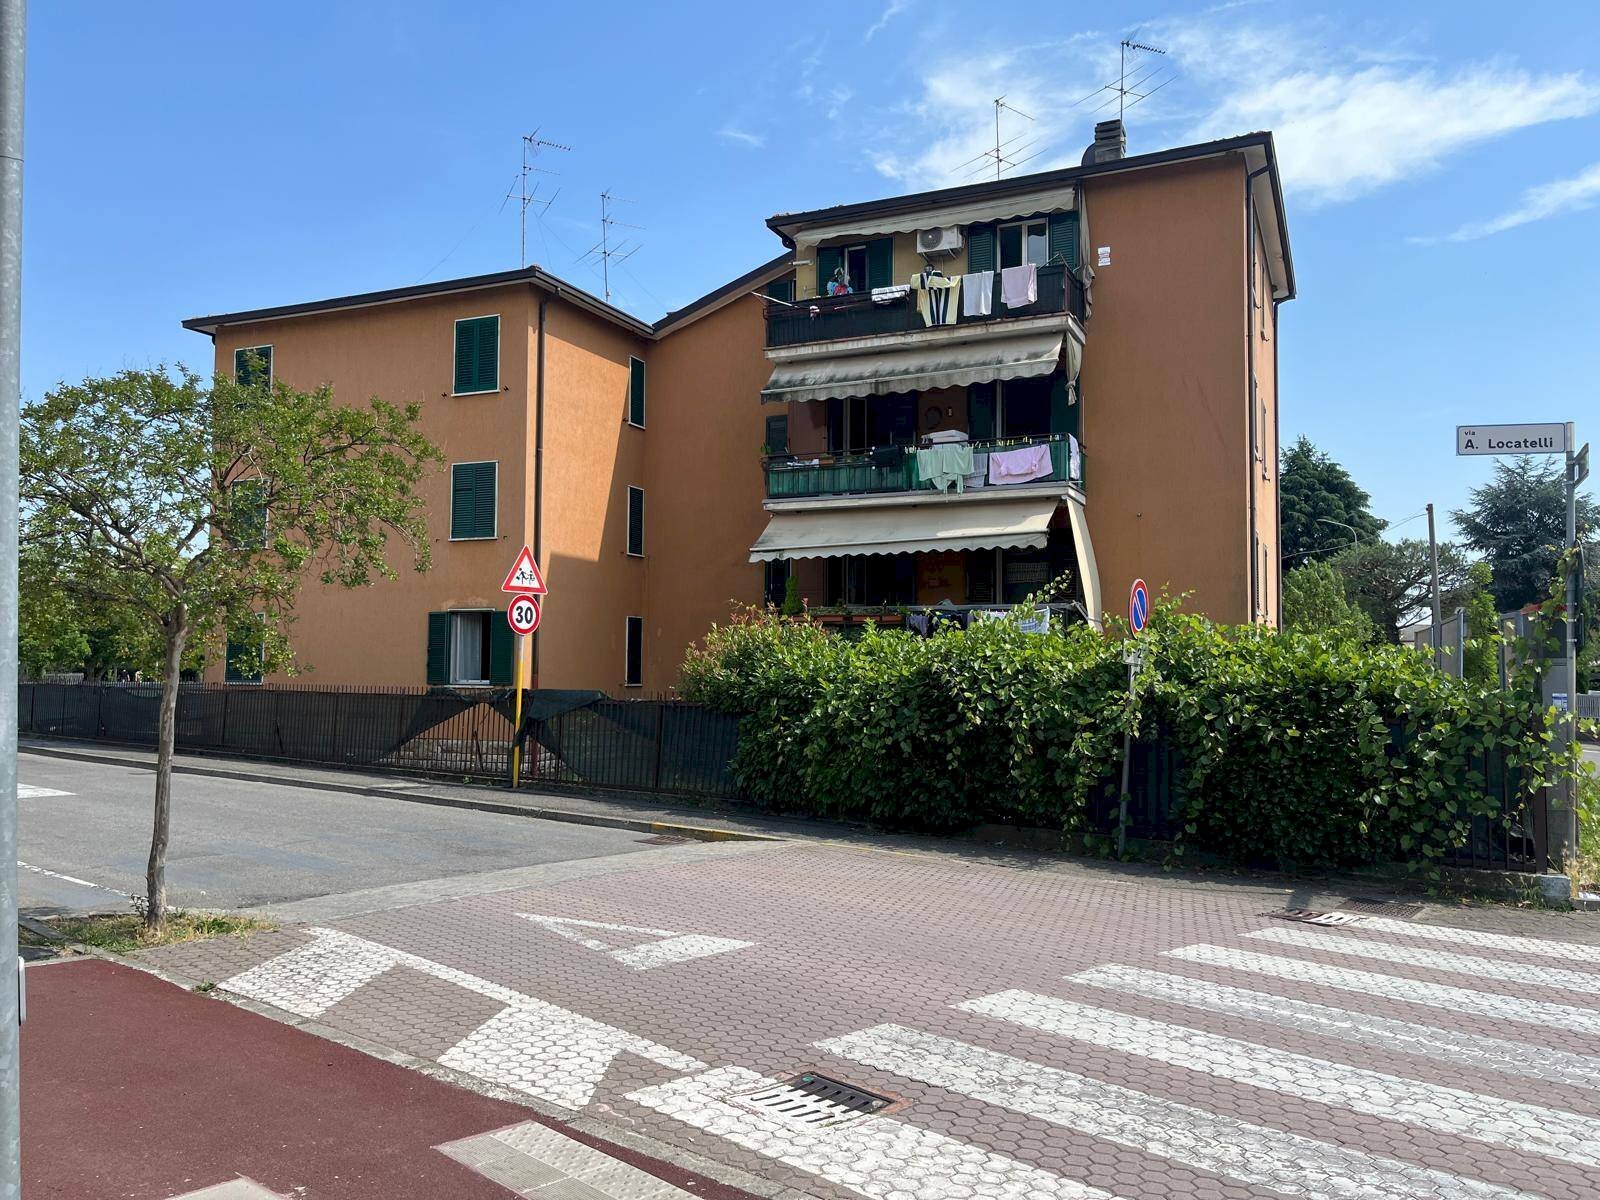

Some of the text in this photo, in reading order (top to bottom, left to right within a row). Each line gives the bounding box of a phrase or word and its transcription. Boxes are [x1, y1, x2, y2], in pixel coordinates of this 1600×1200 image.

[1464, 437, 1553, 450] A. Locatelli
[515, 605, 534, 625] 30
